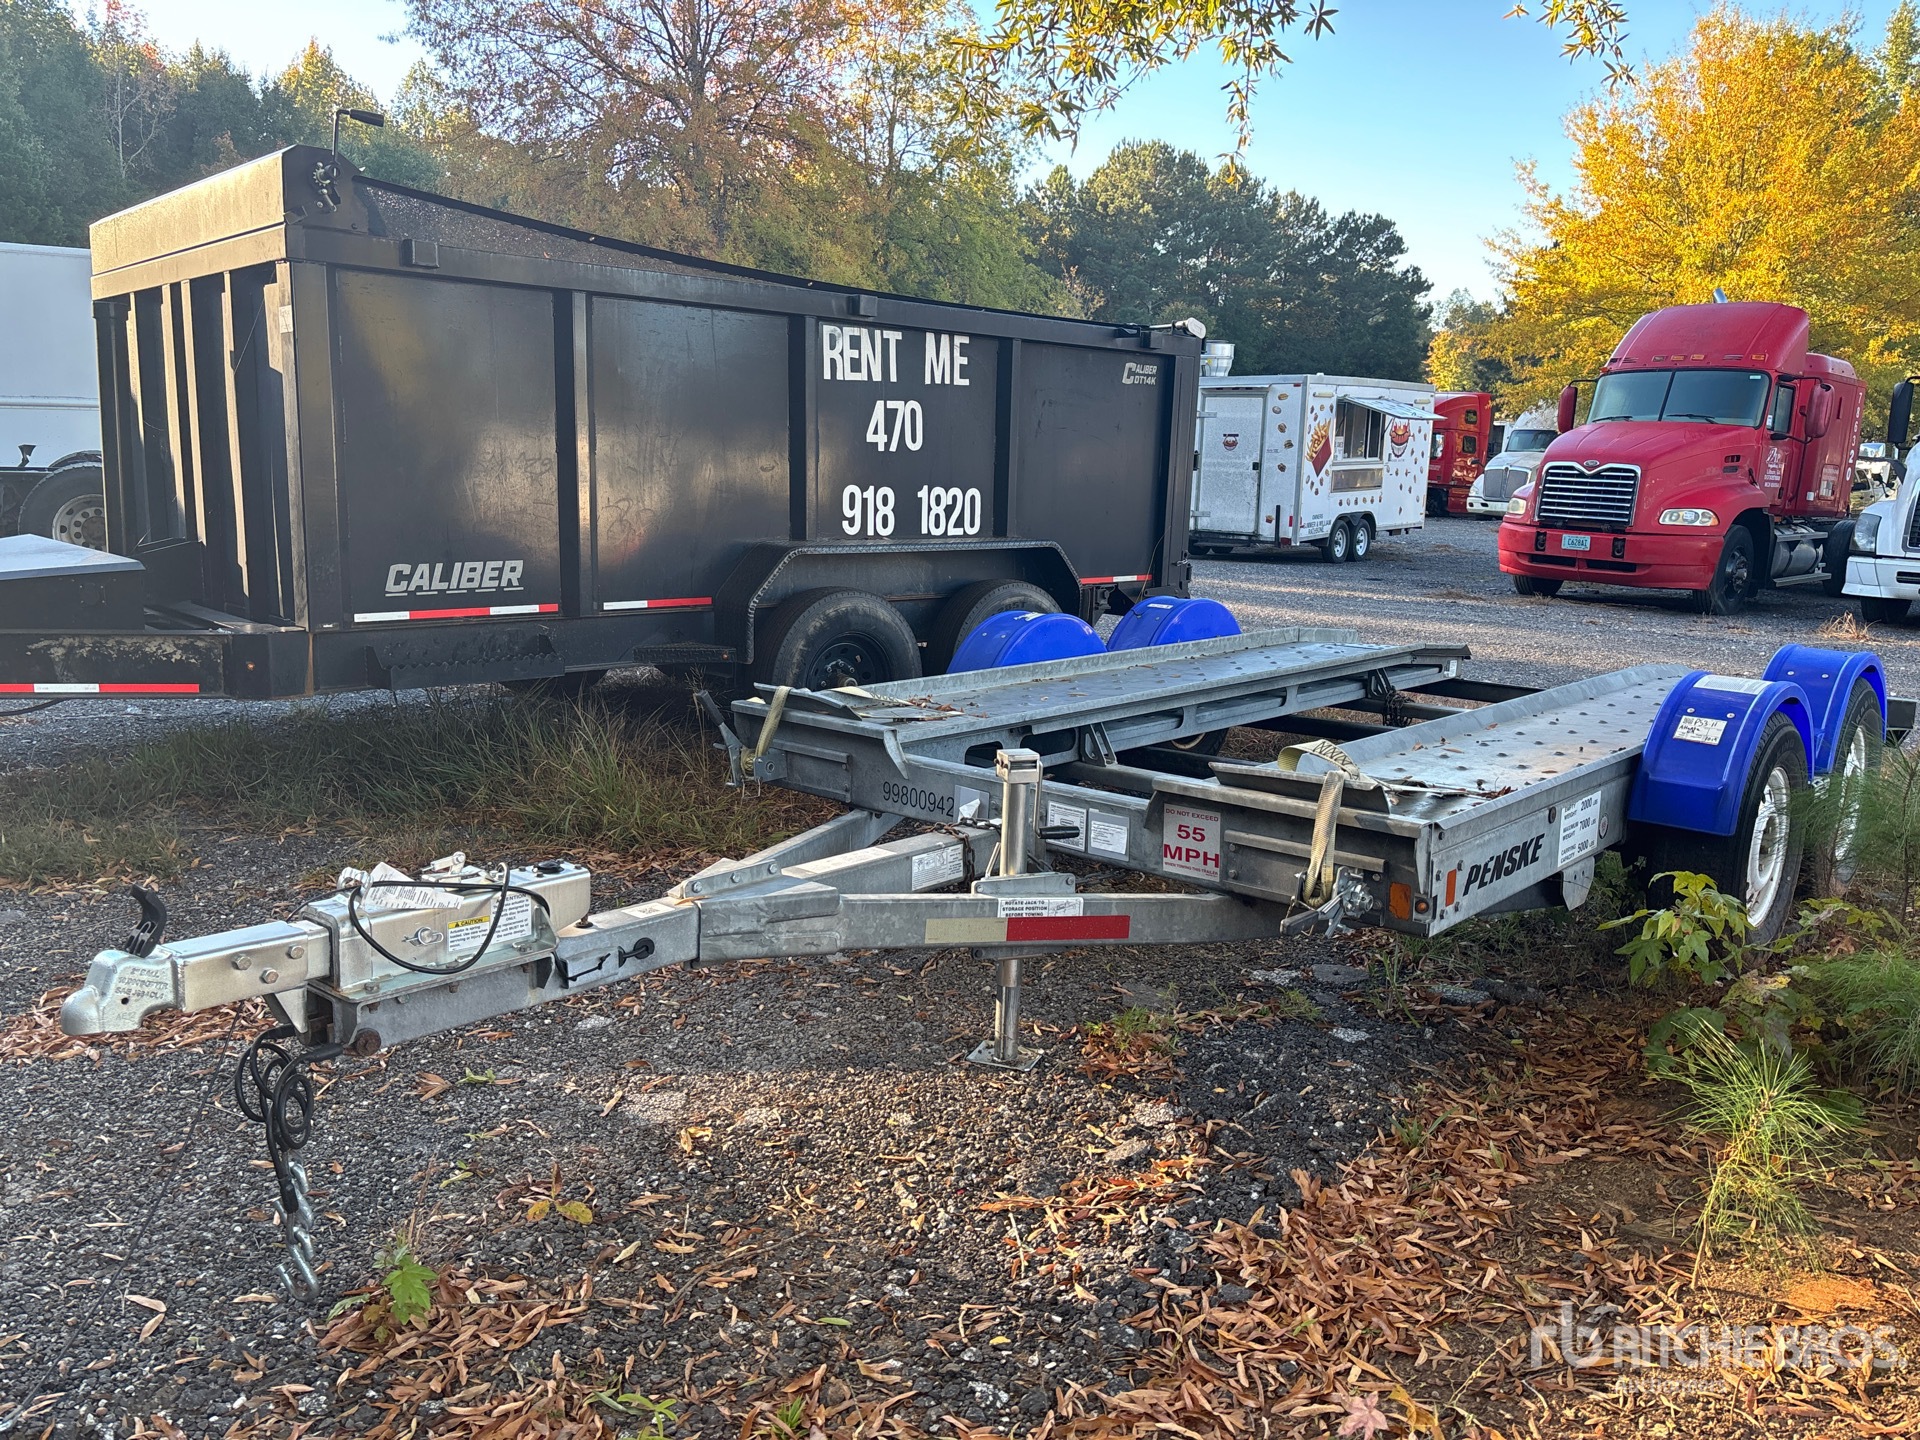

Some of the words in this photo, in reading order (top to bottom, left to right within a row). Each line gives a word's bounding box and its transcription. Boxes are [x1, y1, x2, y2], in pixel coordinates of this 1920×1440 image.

[823, 325, 902, 382] RENT
[925, 332, 970, 386] ME
[866, 400, 923, 452] 470
[842, 484, 895, 536] 918
[917, 484, 981, 536] 1820
[384, 560, 524, 593] CALIBER
[883, 781, 954, 817] 99800942
[1581, 797, 1593, 811] 2000
[1191, 812, 1219, 822] EXCEED
[1579, 817, 1591, 831] 7000
[1177, 823, 1206, 842] 55
[1163, 843, 1219, 868] MPH
[1462, 833, 1545, 897] PENSKE
[460, 918, 483, 926] CAUTION
